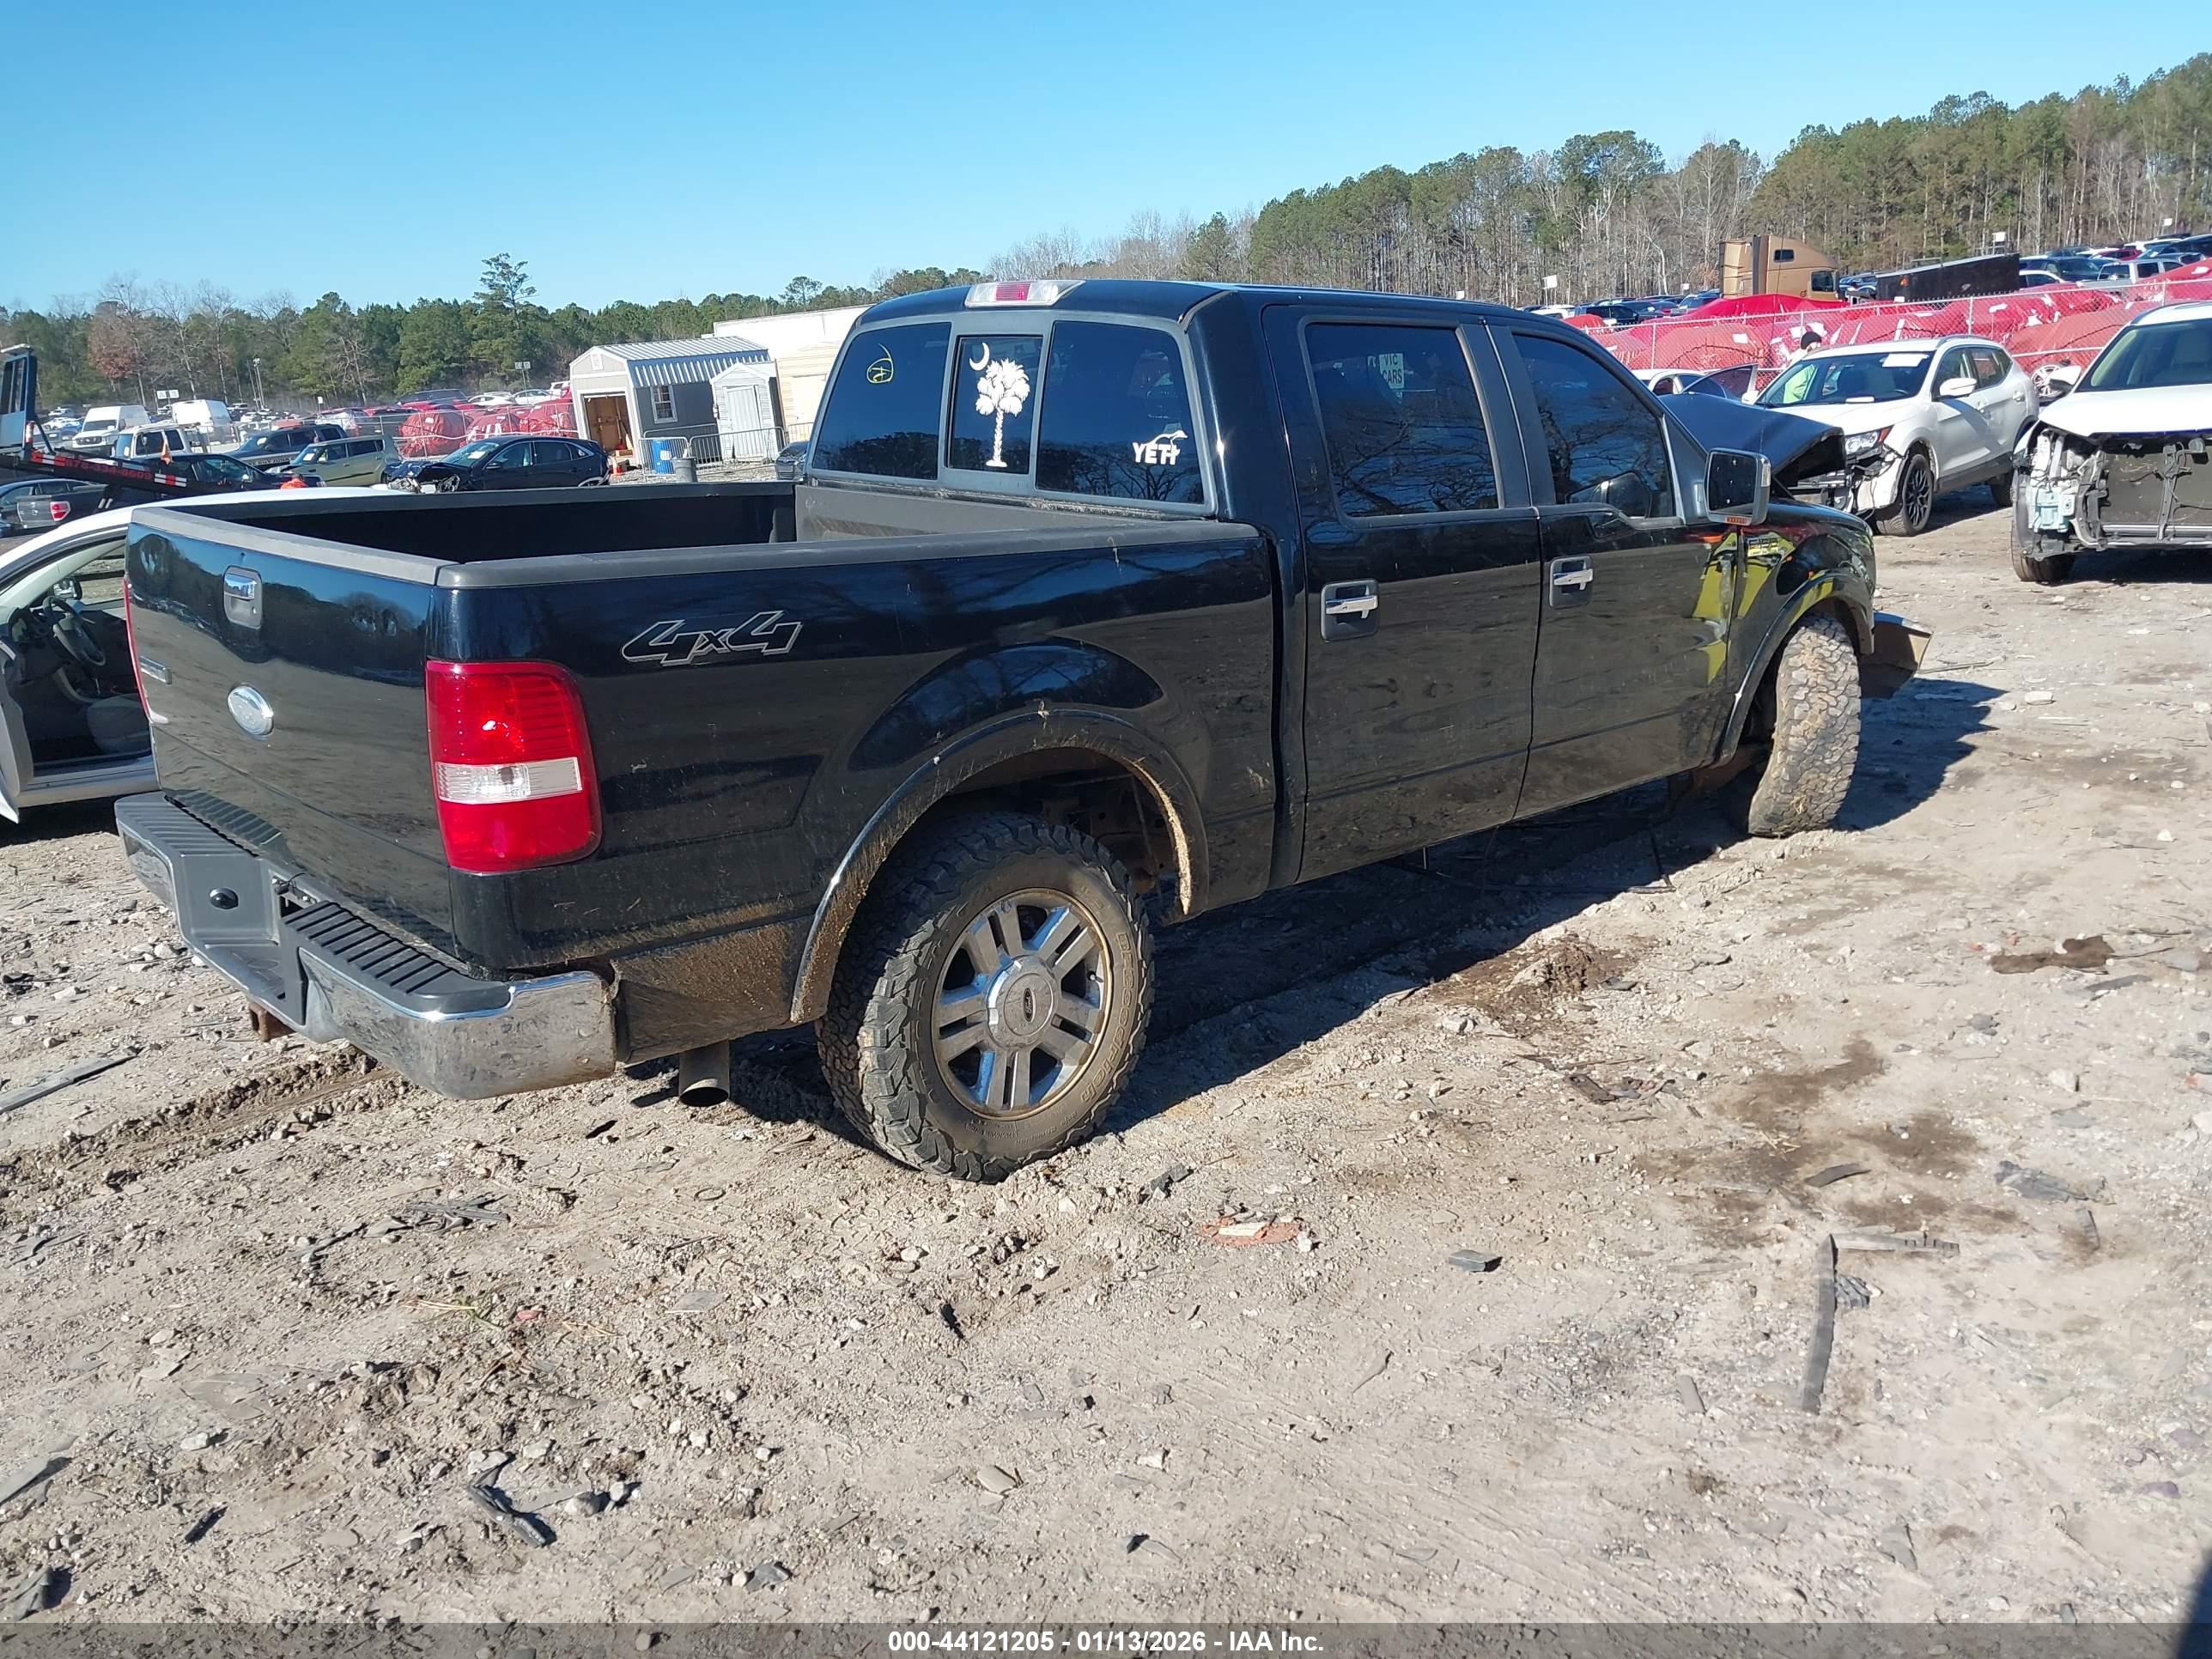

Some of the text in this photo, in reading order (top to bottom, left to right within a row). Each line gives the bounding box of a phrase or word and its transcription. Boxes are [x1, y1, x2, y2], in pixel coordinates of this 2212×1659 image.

[1383, 355, 1398, 366] VIC
[1382, 369, 1402, 384] CARS
[620, 611, 804, 667] 4x4
